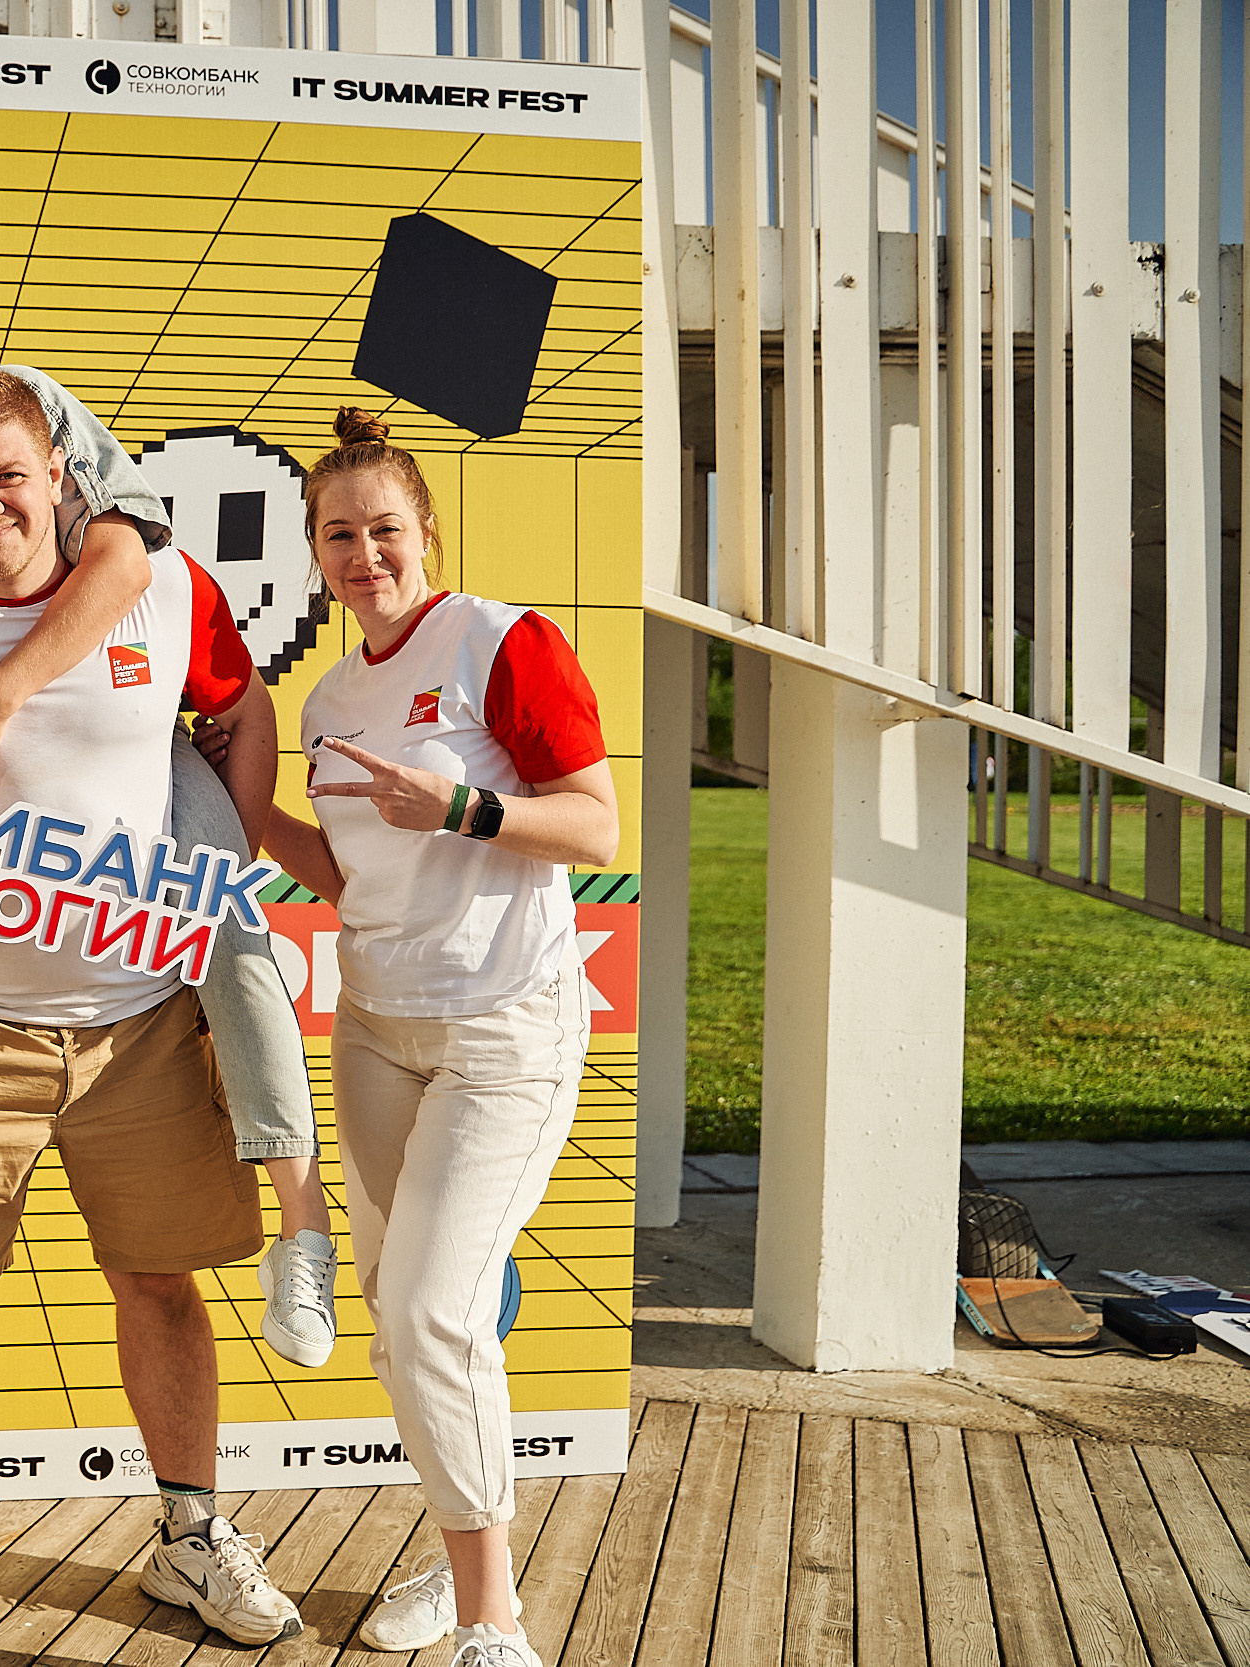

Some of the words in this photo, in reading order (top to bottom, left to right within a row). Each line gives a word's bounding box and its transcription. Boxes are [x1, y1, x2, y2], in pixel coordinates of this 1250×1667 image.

[126, 64, 259, 84] СОВКОМБАНК
[127, 80, 226, 97] ТЕХНОЛОГИИ
[292, 76, 326, 99] IT
[333, 79, 490, 108] SUMMER
[498, 89, 588, 114] FEST
[113, 662, 147, 672] SUMMER
[115, 676, 138, 685] 2023
[283, 1446, 316, 1467] IT
[323, 1442, 410, 1466] SUM
[513, 1436, 574, 1458] EST
